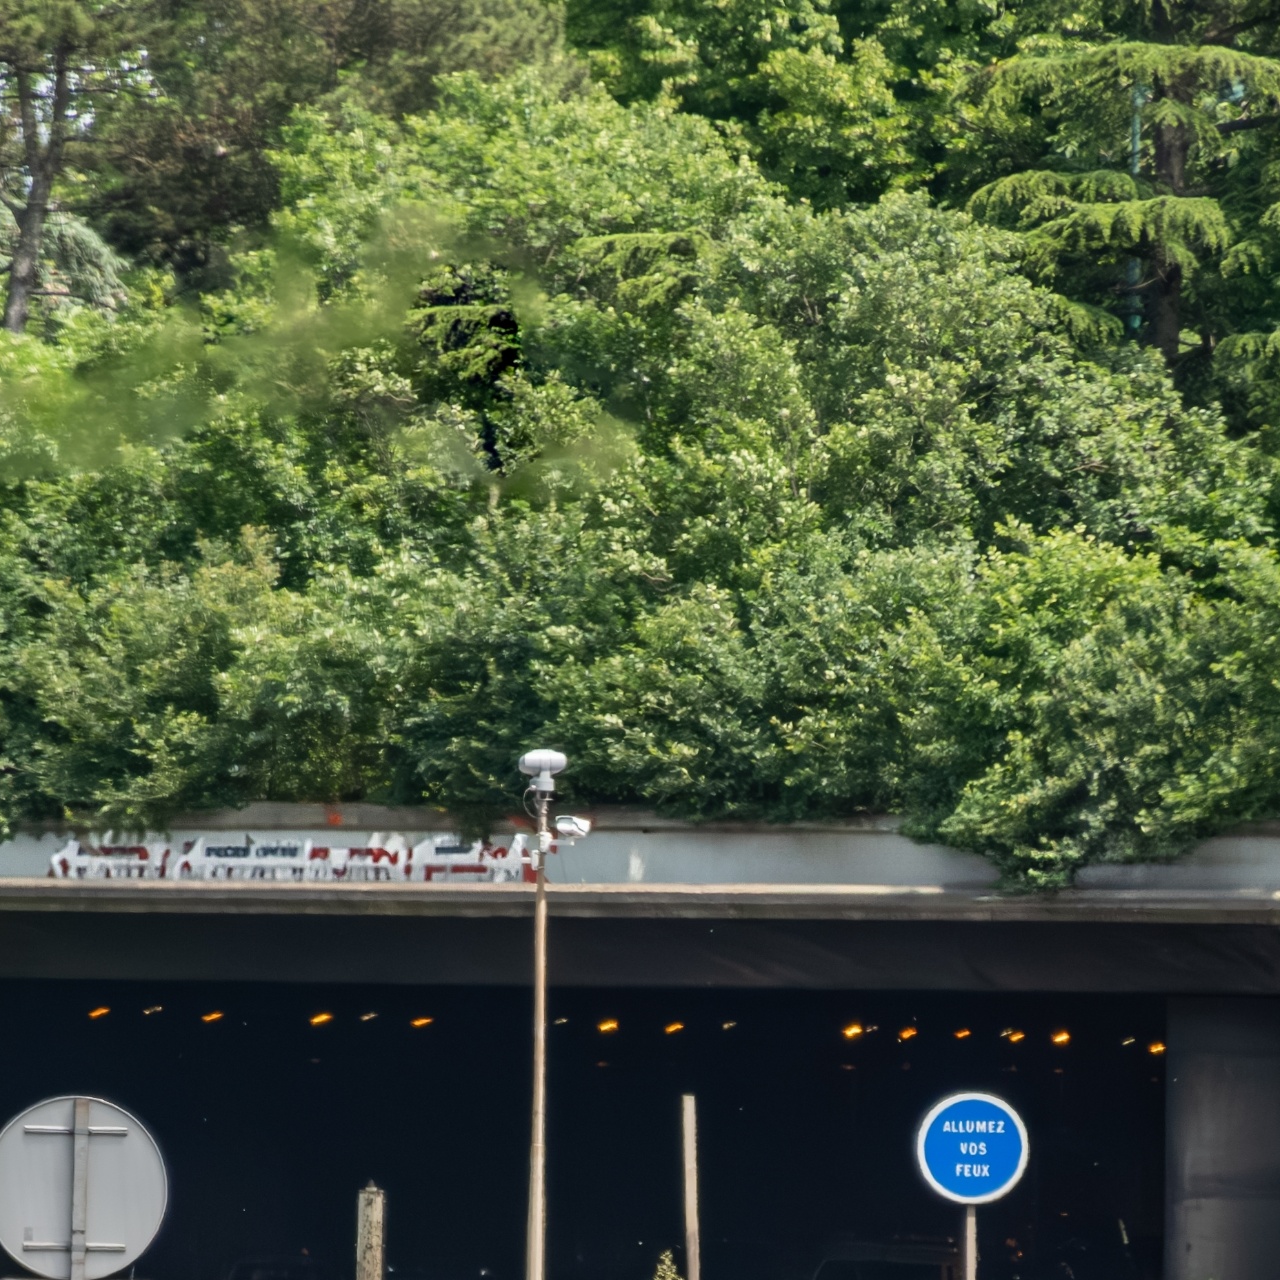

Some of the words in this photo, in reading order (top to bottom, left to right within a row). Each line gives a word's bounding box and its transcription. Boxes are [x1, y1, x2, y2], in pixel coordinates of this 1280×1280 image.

[943, 1120, 1005, 1133] ALLUMEZ
[960, 1142, 987, 1155] VOS
[955, 1164, 990, 1177] FEUX
